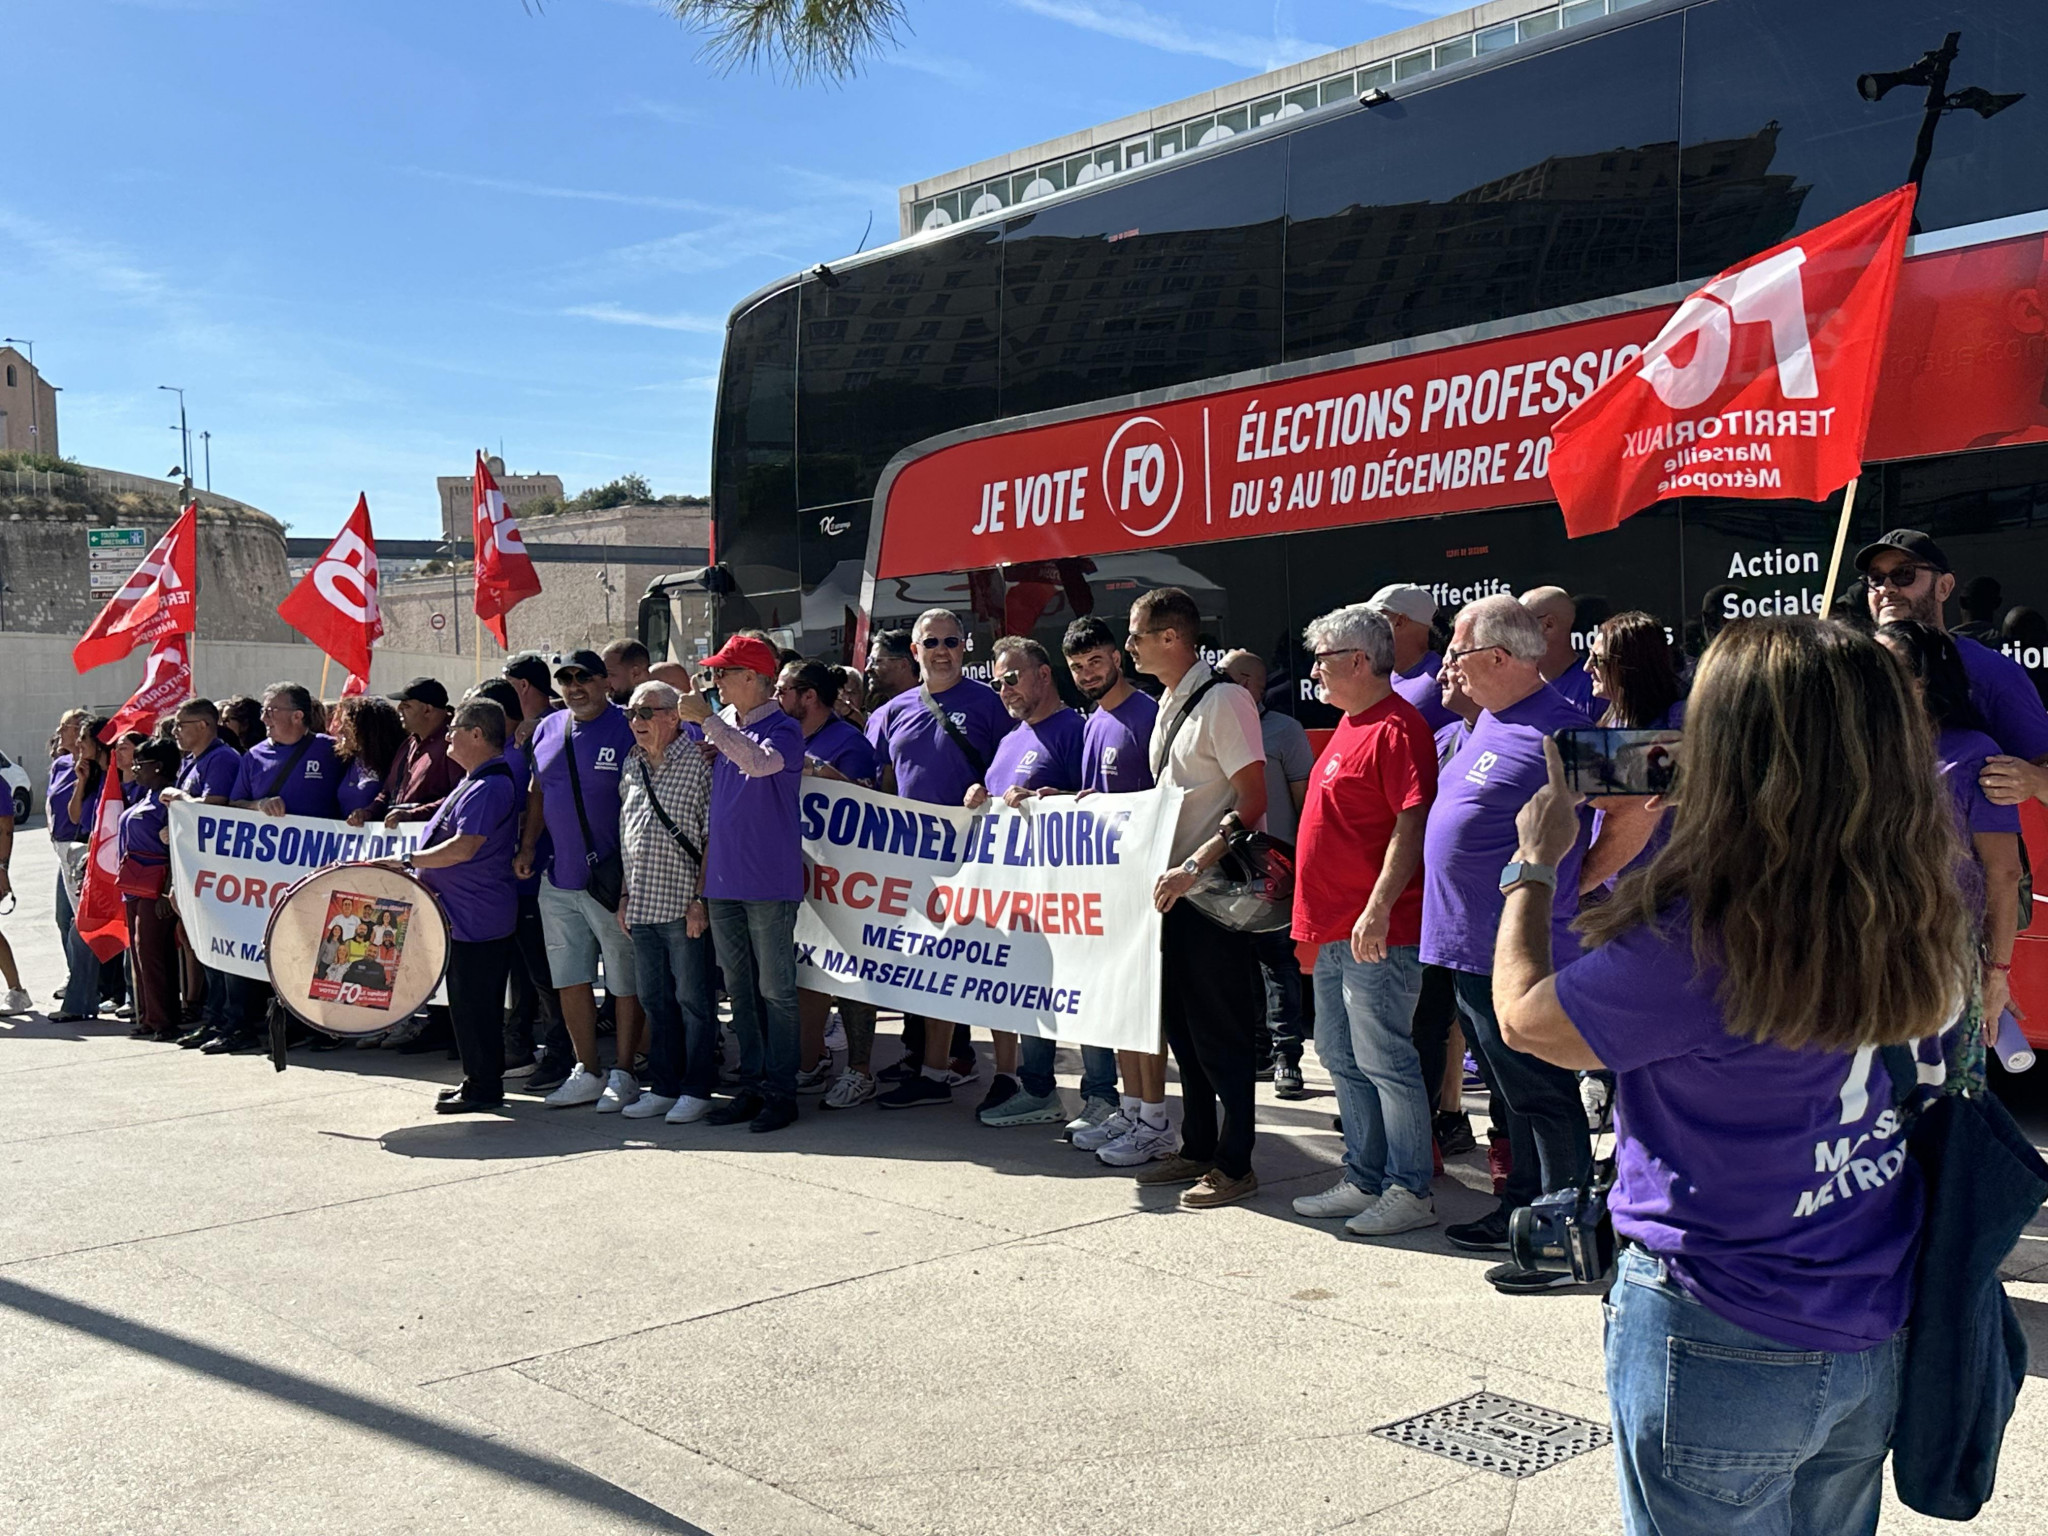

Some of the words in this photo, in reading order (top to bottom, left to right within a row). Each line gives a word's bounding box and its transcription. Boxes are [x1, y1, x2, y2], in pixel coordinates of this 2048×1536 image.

[1236, 385, 1413, 463] ÉLECTIONS
[1420, 343, 1643, 433] PROFESSIO
[1120, 443, 1165, 511] FO
[1229, 479, 1262, 518] DU
[1267, 476, 1283, 513] 3
[1287, 470, 1324, 511] AU
[1330, 465, 1356, 505] 10
[1361, 444, 1510, 501] DÉCEMBRE
[1513, 436, 1552, 482] 20
[972, 481, 1008, 536] JE
[1014, 467, 1089, 529] VOTE
[1727, 548, 1819, 579] Action
[1419, 578, 1511, 606] ffectifs
[1722, 588, 1825, 619] Sociale
[306, 760, 320, 772] FO
[597, 747, 616, 762] FO
[1020, 750, 1038, 765] FO
[1103, 746, 1117, 764] FO
[1474, 750, 1498, 773] FO
[802, 792, 957, 863] SONNEL
[963, 813, 999, 865] DE
[194, 870, 291, 909] FORC
[802, 863, 913, 917] RCE
[926, 885, 1104, 936] OUVRIERE
[211, 936, 236, 958] AIX
[240, 943, 266, 963] MA
[862, 924, 1011, 968] MÉTROPOLE
[337, 982, 362, 1004] FO
[822, 951, 958, 996] MARSEILLE
[961, 976, 1081, 1014] PROVENCE
